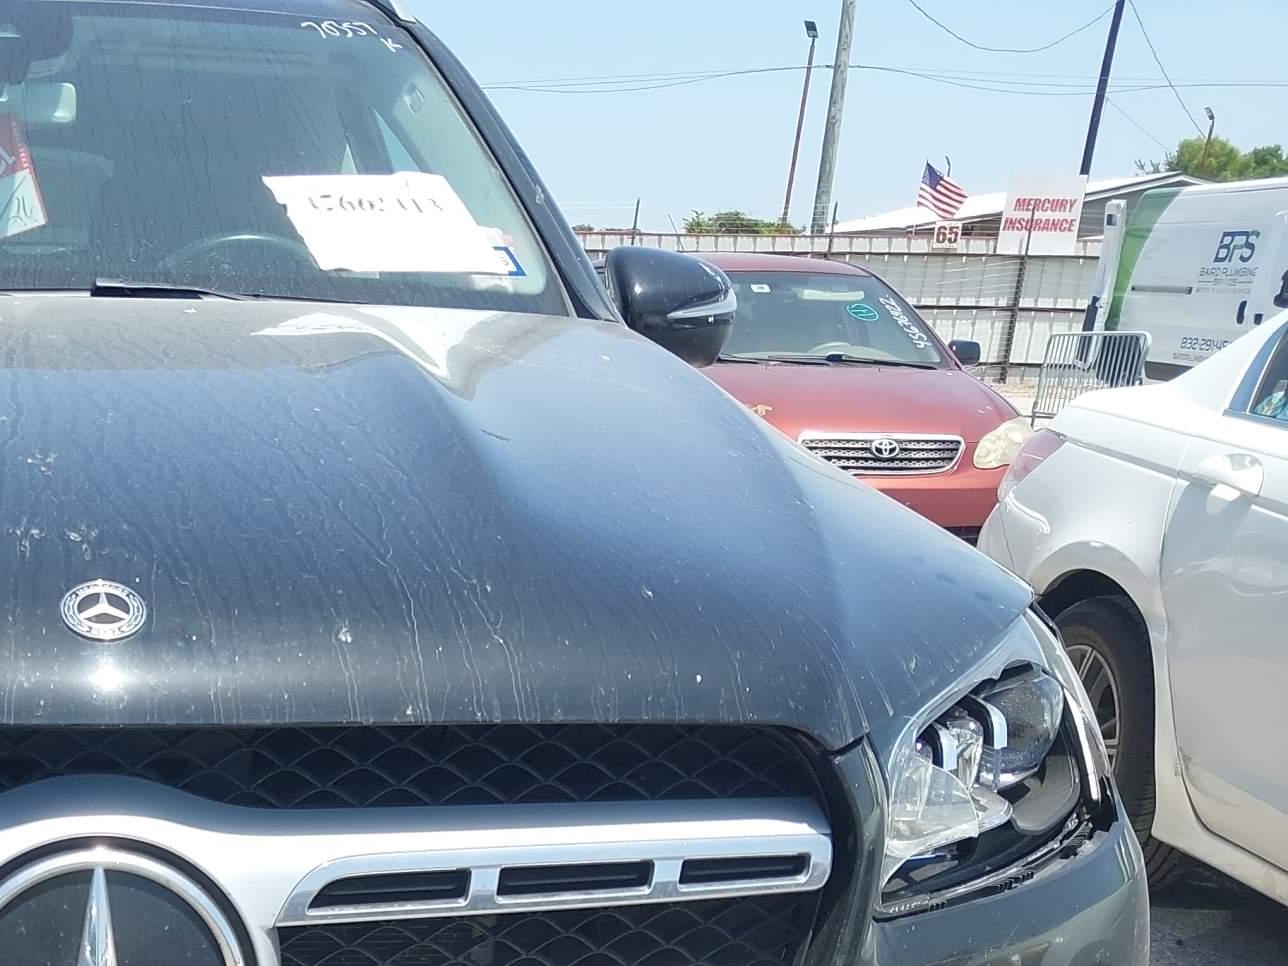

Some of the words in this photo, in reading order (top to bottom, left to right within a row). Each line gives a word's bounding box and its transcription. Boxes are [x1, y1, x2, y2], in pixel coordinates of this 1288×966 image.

[1013, 197, 1077, 213] MERCURY
[1002, 216, 1077, 233] INSURANCE
[935, 224, 960, 245] 65
[1213, 230, 1261, 263] BFS
